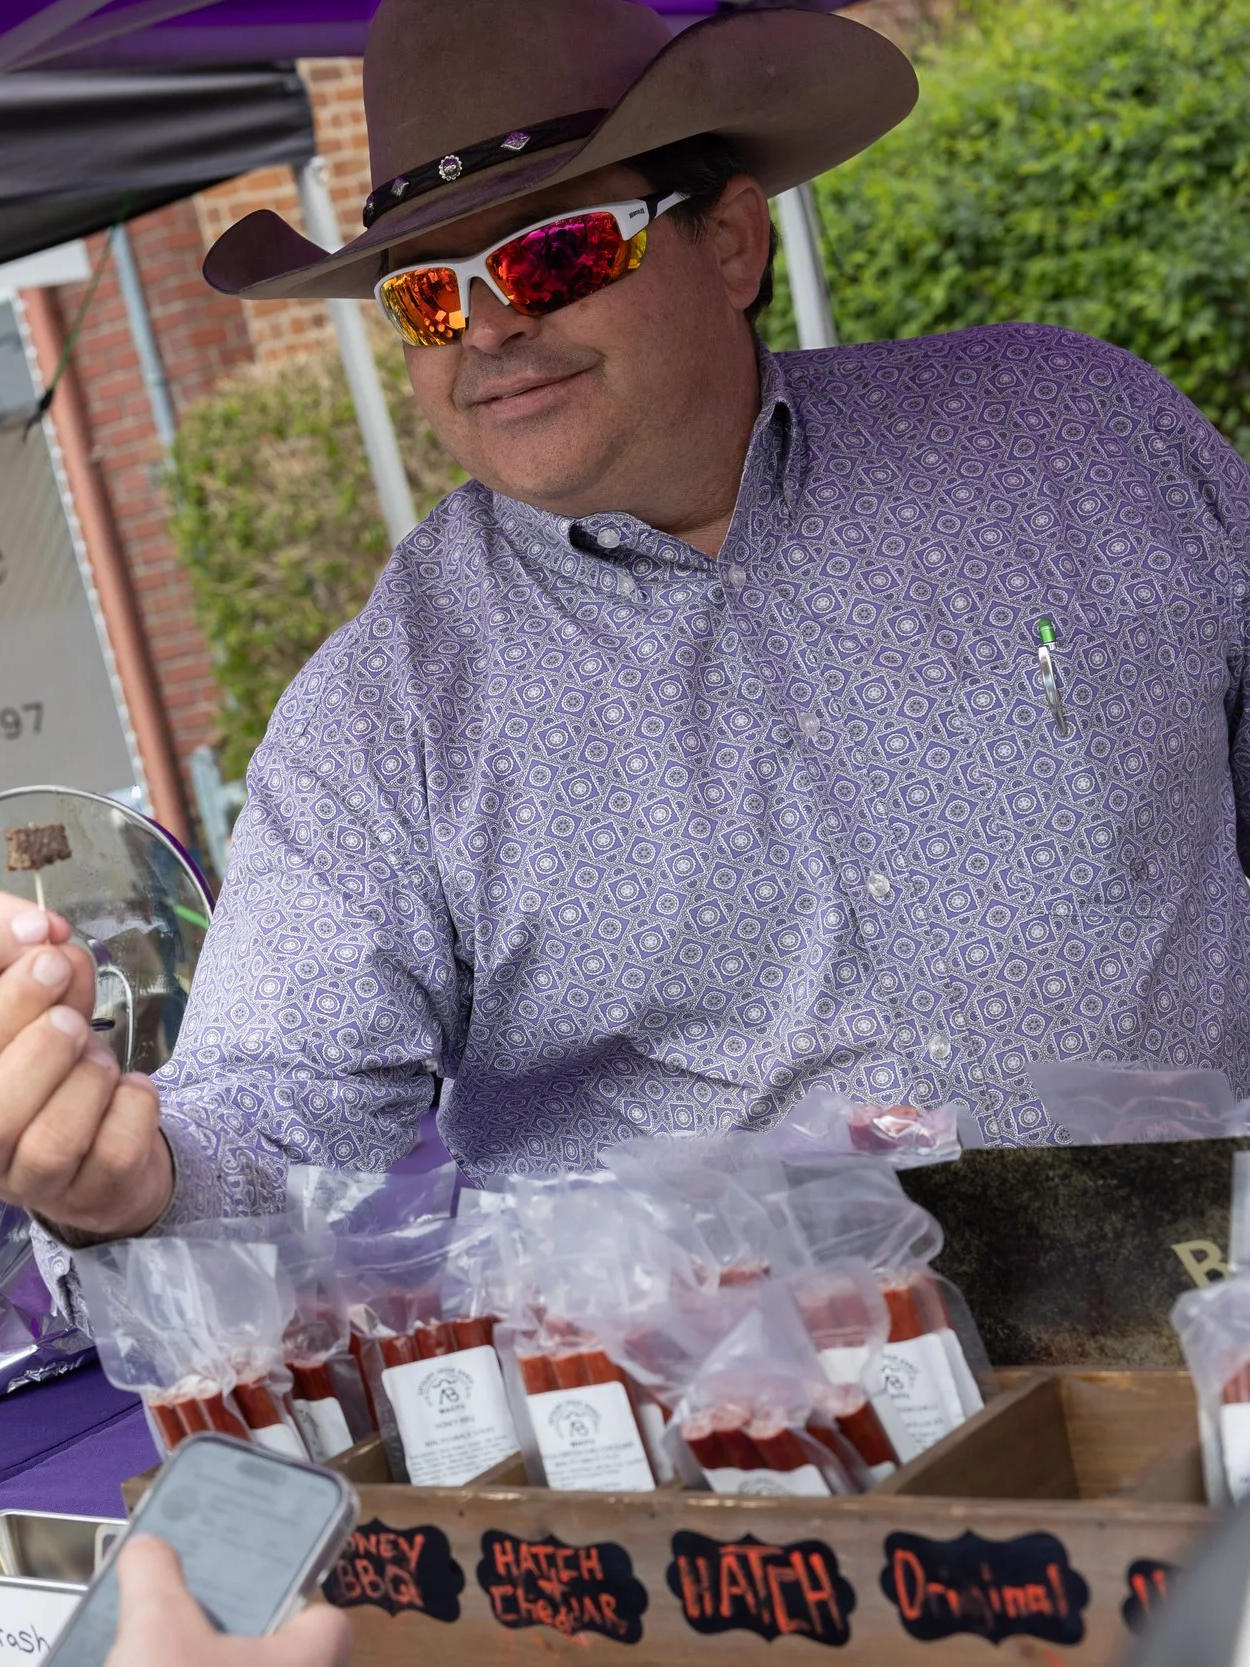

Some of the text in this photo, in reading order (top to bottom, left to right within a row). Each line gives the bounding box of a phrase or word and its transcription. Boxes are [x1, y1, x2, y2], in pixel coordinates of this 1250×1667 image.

[336, 1558, 425, 1608] BBQ
[493, 1540, 605, 1582] HATCH
[678, 1544, 844, 1634] HATCH
